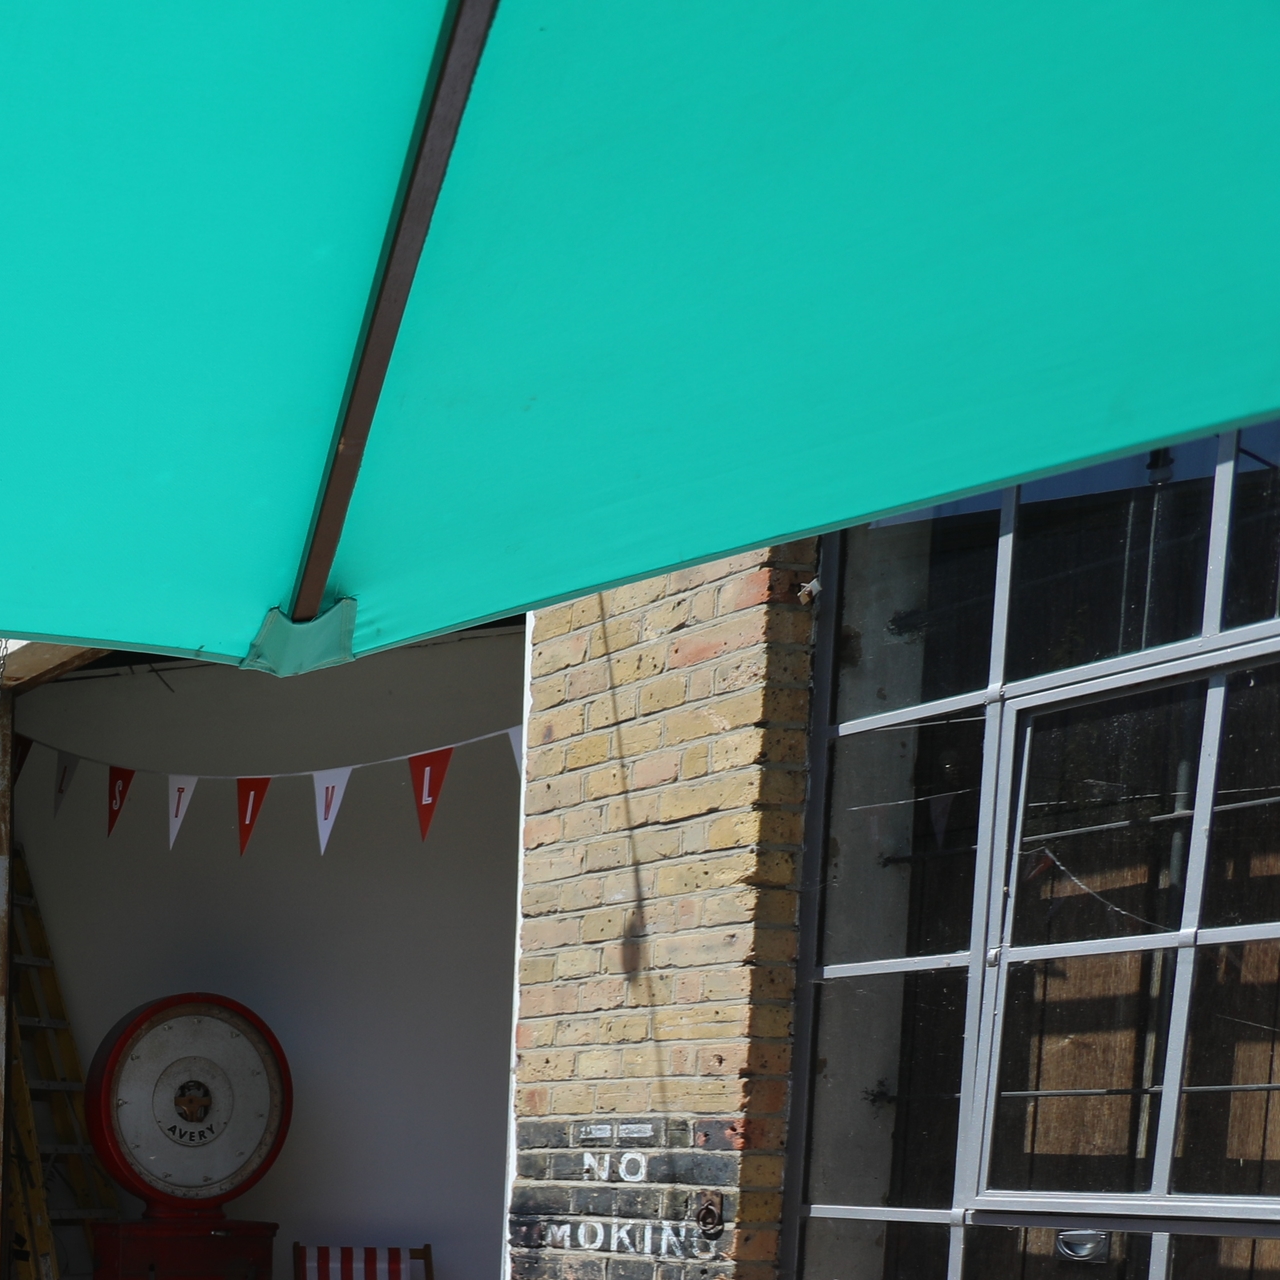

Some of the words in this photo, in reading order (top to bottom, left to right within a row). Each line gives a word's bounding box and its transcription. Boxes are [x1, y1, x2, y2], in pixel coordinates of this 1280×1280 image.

[112, 780, 123, 810] S
[174, 787, 185, 818] T
[324, 785, 336, 821] V
[422, 766, 432, 805] L
[167, 1124, 215, 1142] AVERY
[583, 1152, 646, 1182] NO
